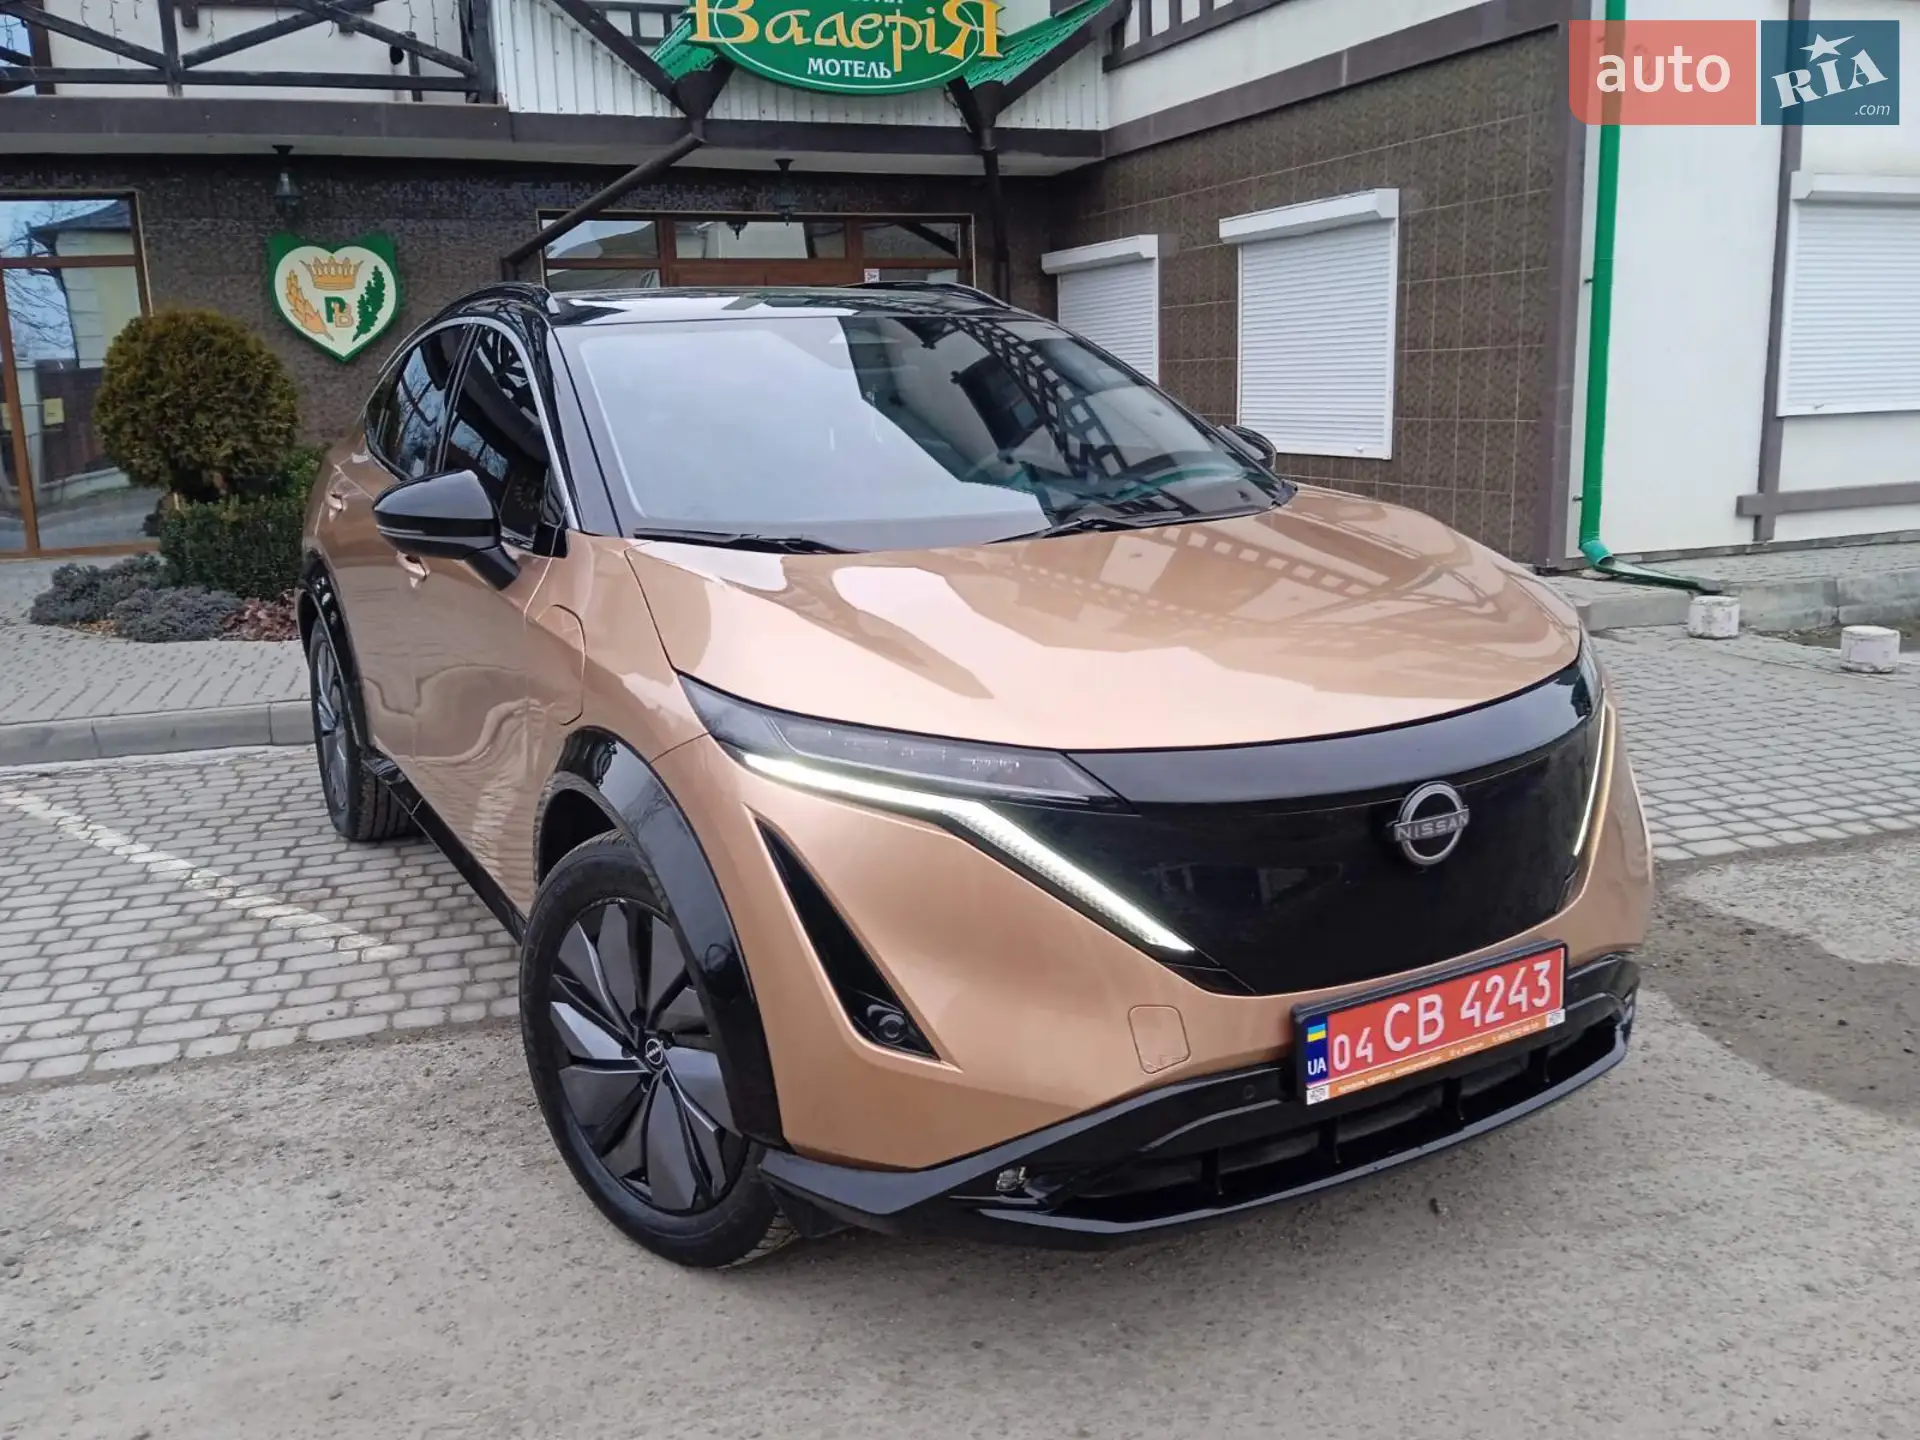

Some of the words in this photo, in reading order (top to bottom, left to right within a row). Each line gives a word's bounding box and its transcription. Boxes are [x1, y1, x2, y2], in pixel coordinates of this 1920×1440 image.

[807, 57, 892, 79] МОТЕЛЬ
[1396, 811, 1468, 841] NISSAN
[1332, 1026, 1373, 1072] 04
[1459, 959, 1551, 1028] 4243
[1307, 1057, 1327, 1076] UA
